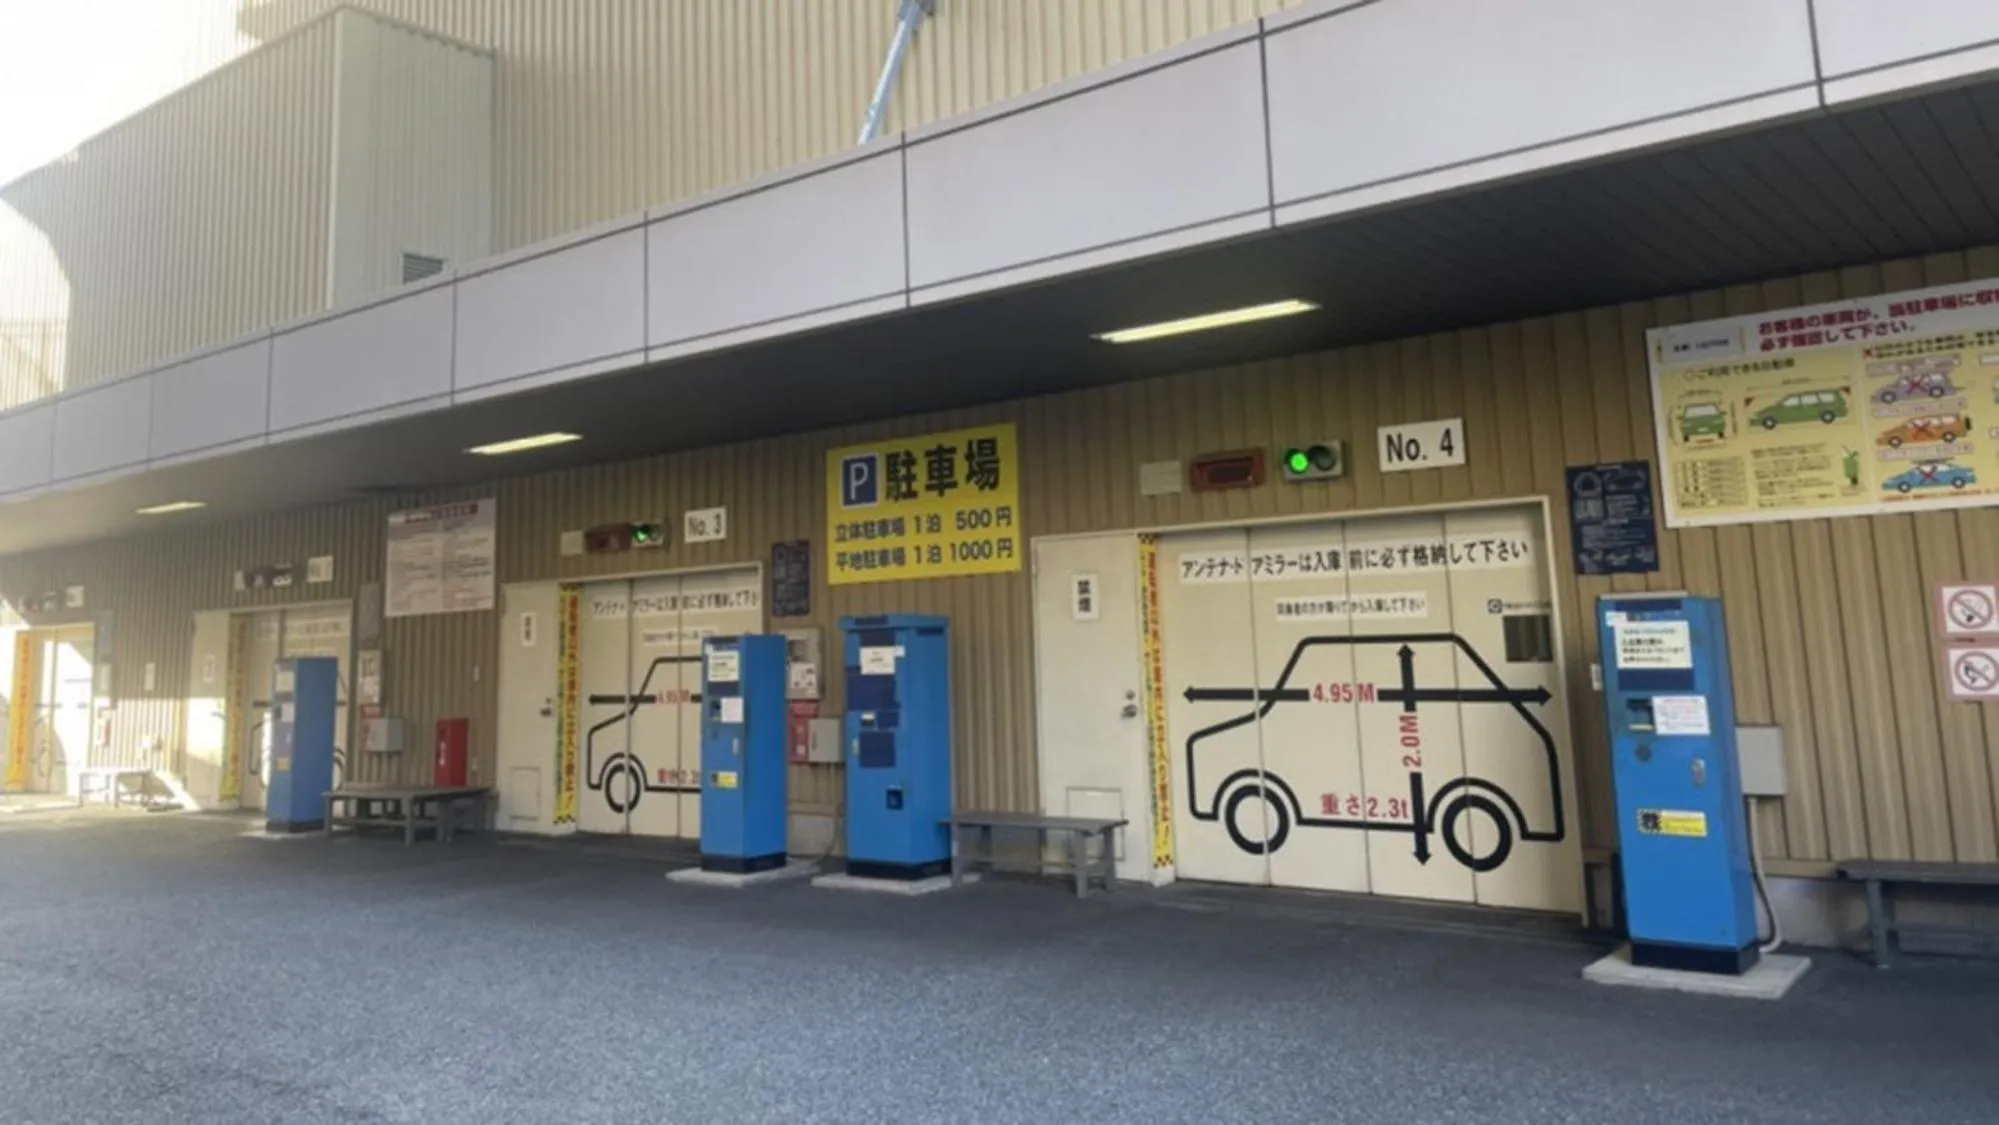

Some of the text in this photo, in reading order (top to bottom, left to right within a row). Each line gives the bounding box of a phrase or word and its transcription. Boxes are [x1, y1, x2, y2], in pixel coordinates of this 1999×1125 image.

[1386, 427, 1454, 463] No. 4
[886, 437, 1000, 501] 駐車場
[835, 517, 905, 543] 立体駐車場
[956, 506, 1012, 530] 500円
[835, 546, 906, 573] 平地駐車場
[951, 537, 1013, 562] 1000円
[1313, 682, 1375, 704] 4.95M
[1398, 714, 1423, 768] 2.0M
